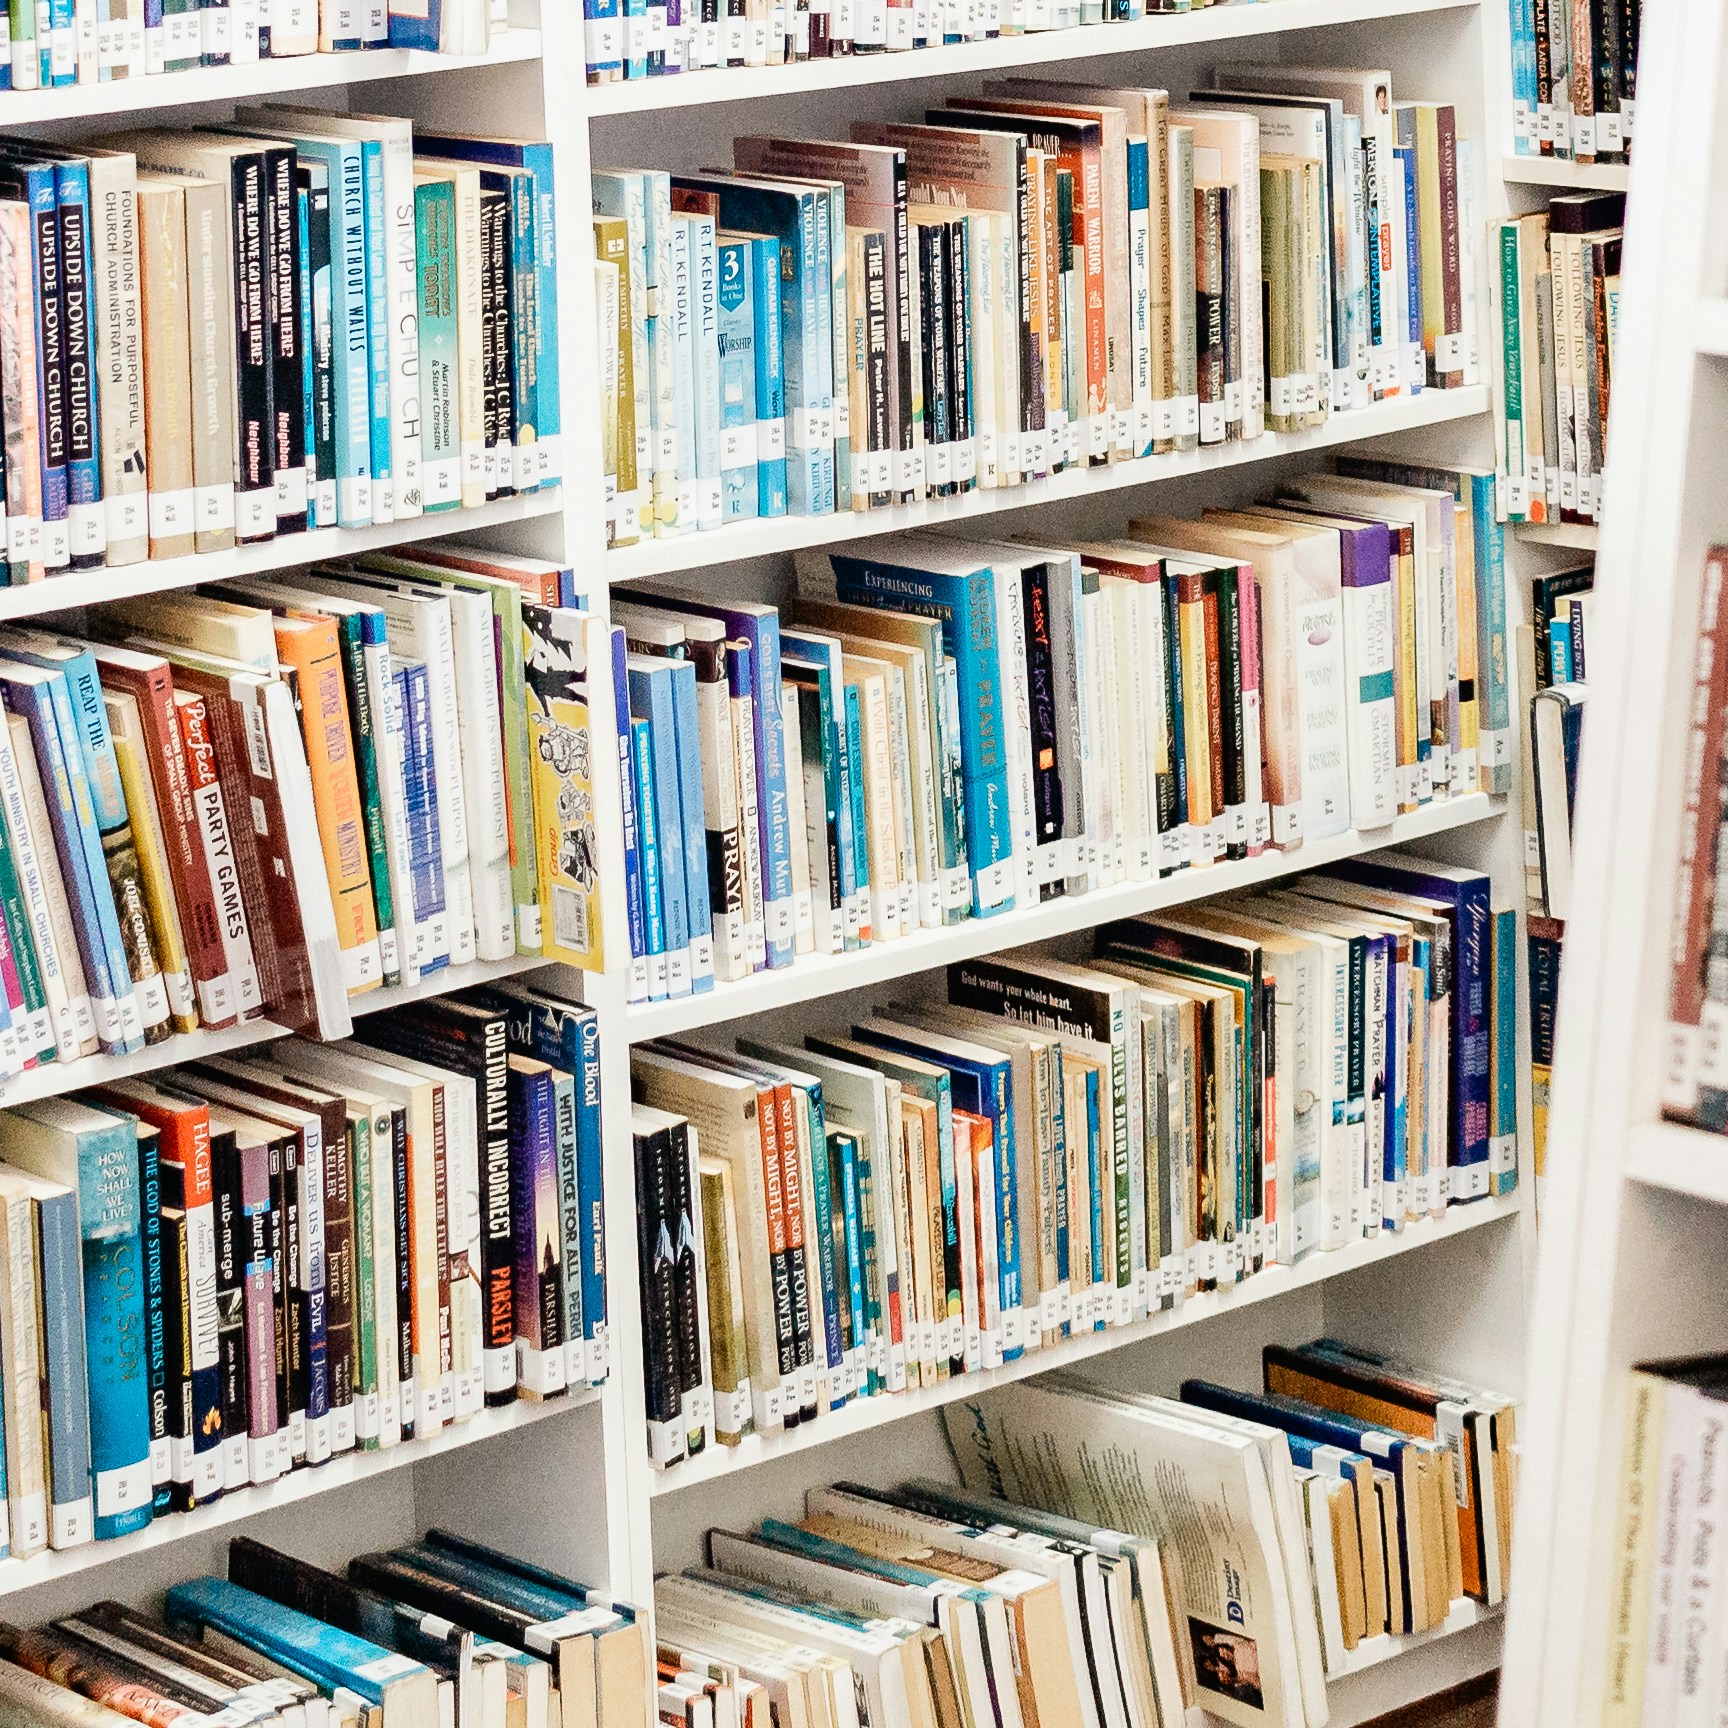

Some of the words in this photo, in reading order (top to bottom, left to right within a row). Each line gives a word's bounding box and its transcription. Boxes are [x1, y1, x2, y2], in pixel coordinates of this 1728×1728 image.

[105, 192, 117, 252] CHURCH
[344, 156, 362, 216] CHURCH
[41, 222, 57, 294] UPSIDE
[65, 215, 82, 285] UPSIDE
[122, 190, 134, 292] FOUNDATIONS
[346, 223, 364, 296] WITHOUT
[701, 224, 711, 251] R.T.
[45, 297, 59, 363] DOWN
[68, 289, 84, 361] DOWN
[108, 257, 122, 383] ADMINISTRATION
[127, 299, 135, 326] FOR
[348, 303, 364, 352] WALLS
[702, 256, 714, 338] KENDALL
[48, 365, 63, 458] CHURCH
[70, 363, 89, 451] CHURCH
[128, 332, 141, 429] PURPOSEFUL
[78, 673, 95, 712] REAP
[88, 714, 104, 752] THE
[186, 697, 215, 783] Perfect
[204, 791, 231, 859] PARTY
[218, 865, 244, 940] GAMES
[581, 1023, 599, 1054] One
[485, 1020, 508, 1131] CULTURALLY
[584, 1059, 599, 1108] Blood
[97, 1178, 132, 1195] SHALL
[98, 1152, 124, 1165] HOW
[103, 1166, 128, 1181] NOW
[193, 1122, 210, 1195] HAGEE
[488, 1138, 510, 1239] INCORRECT
[102, 1203, 133, 1221] LIVE?
[105, 1194, 124, 1208] WE
[491, 1266, 513, 1347] PARSLEY
